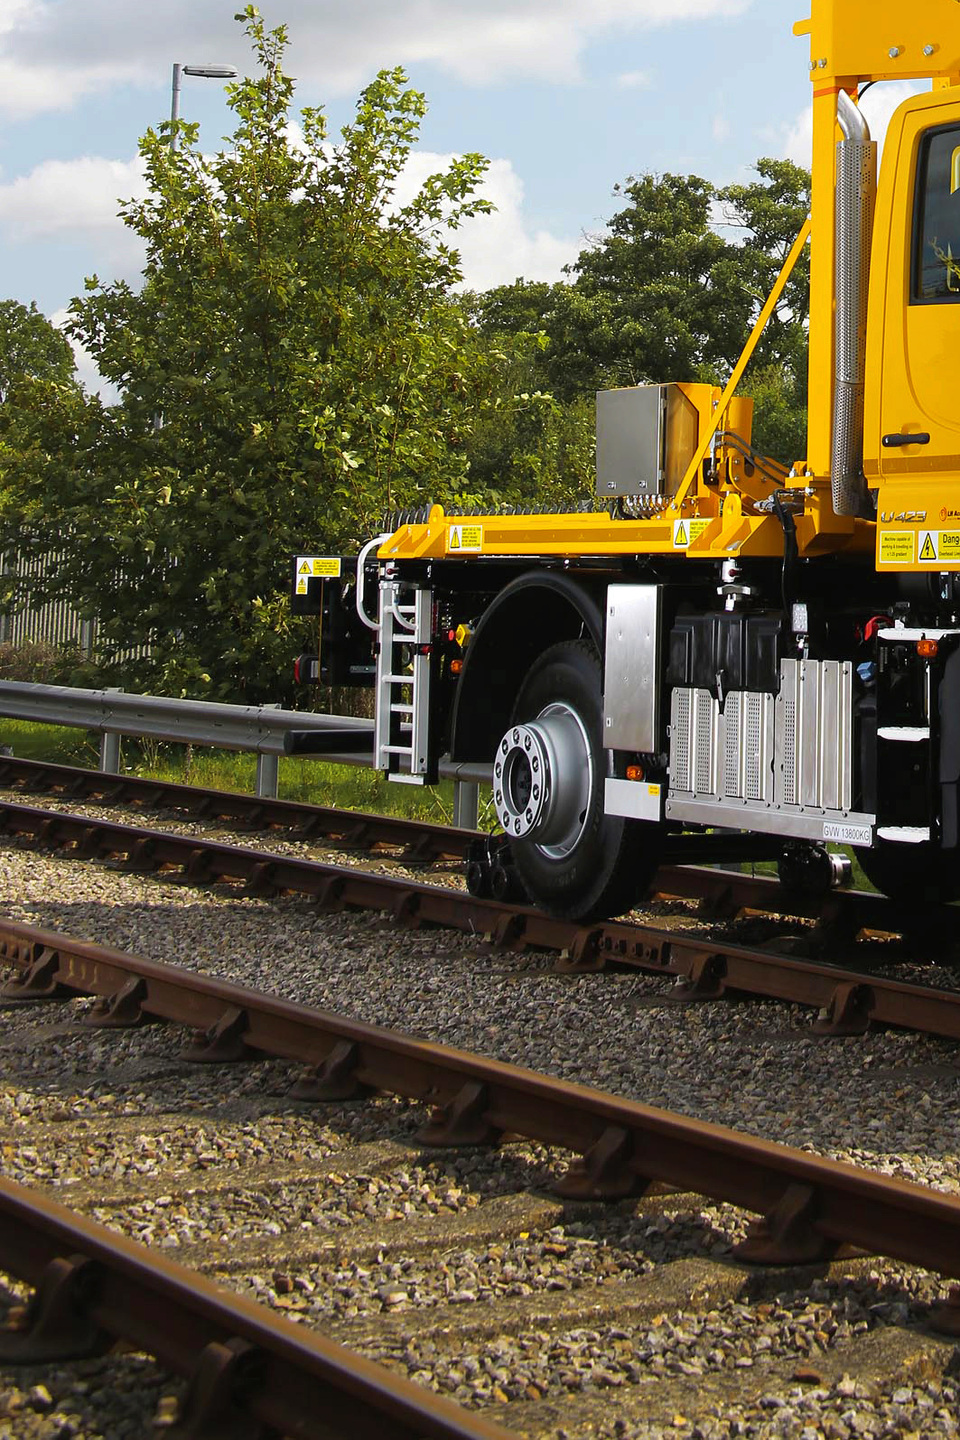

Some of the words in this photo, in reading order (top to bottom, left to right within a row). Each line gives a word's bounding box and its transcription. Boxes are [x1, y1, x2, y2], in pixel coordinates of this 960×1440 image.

[895, 510, 927, 523] 423
[824, 825, 840, 837] GVW
[841, 827, 870, 841] 13800KG
